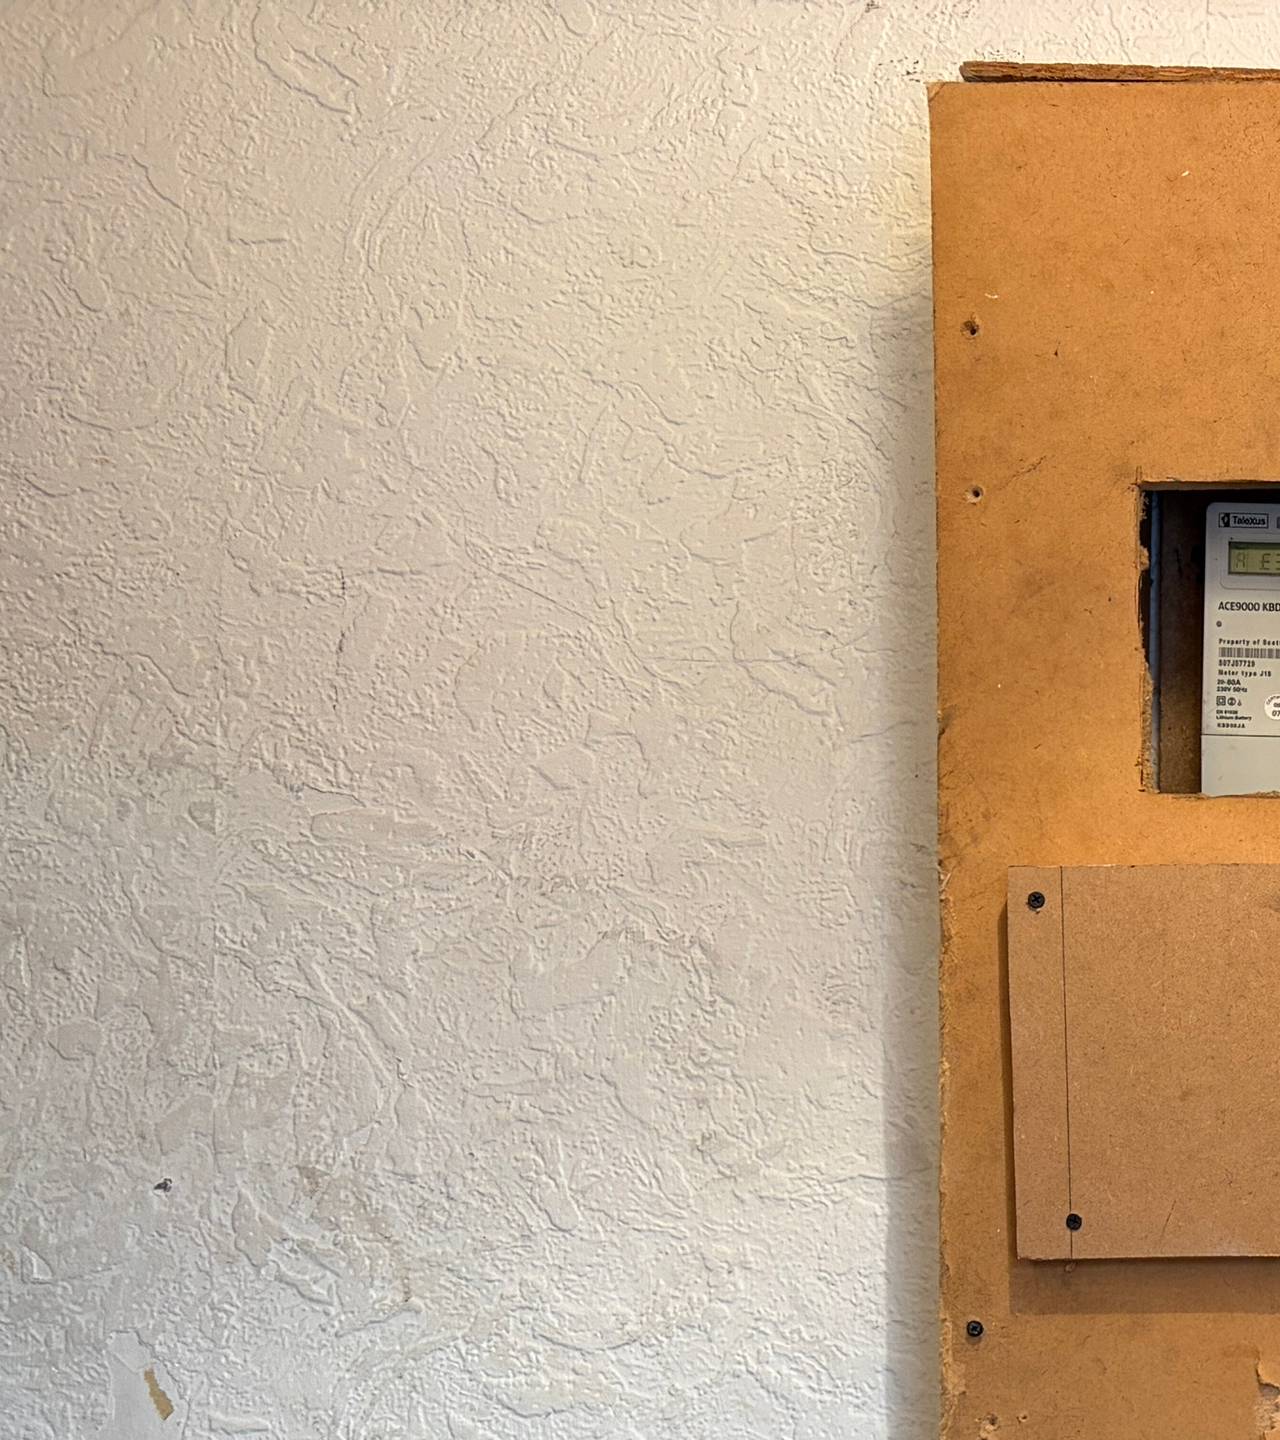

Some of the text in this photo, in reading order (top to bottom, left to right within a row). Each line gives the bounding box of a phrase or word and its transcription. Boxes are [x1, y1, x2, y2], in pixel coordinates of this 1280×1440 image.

[1217, 601, 1260, 612] ACE9000
[1218, 638, 1250, 647] Property
[1241, 670, 1257, 678] type
